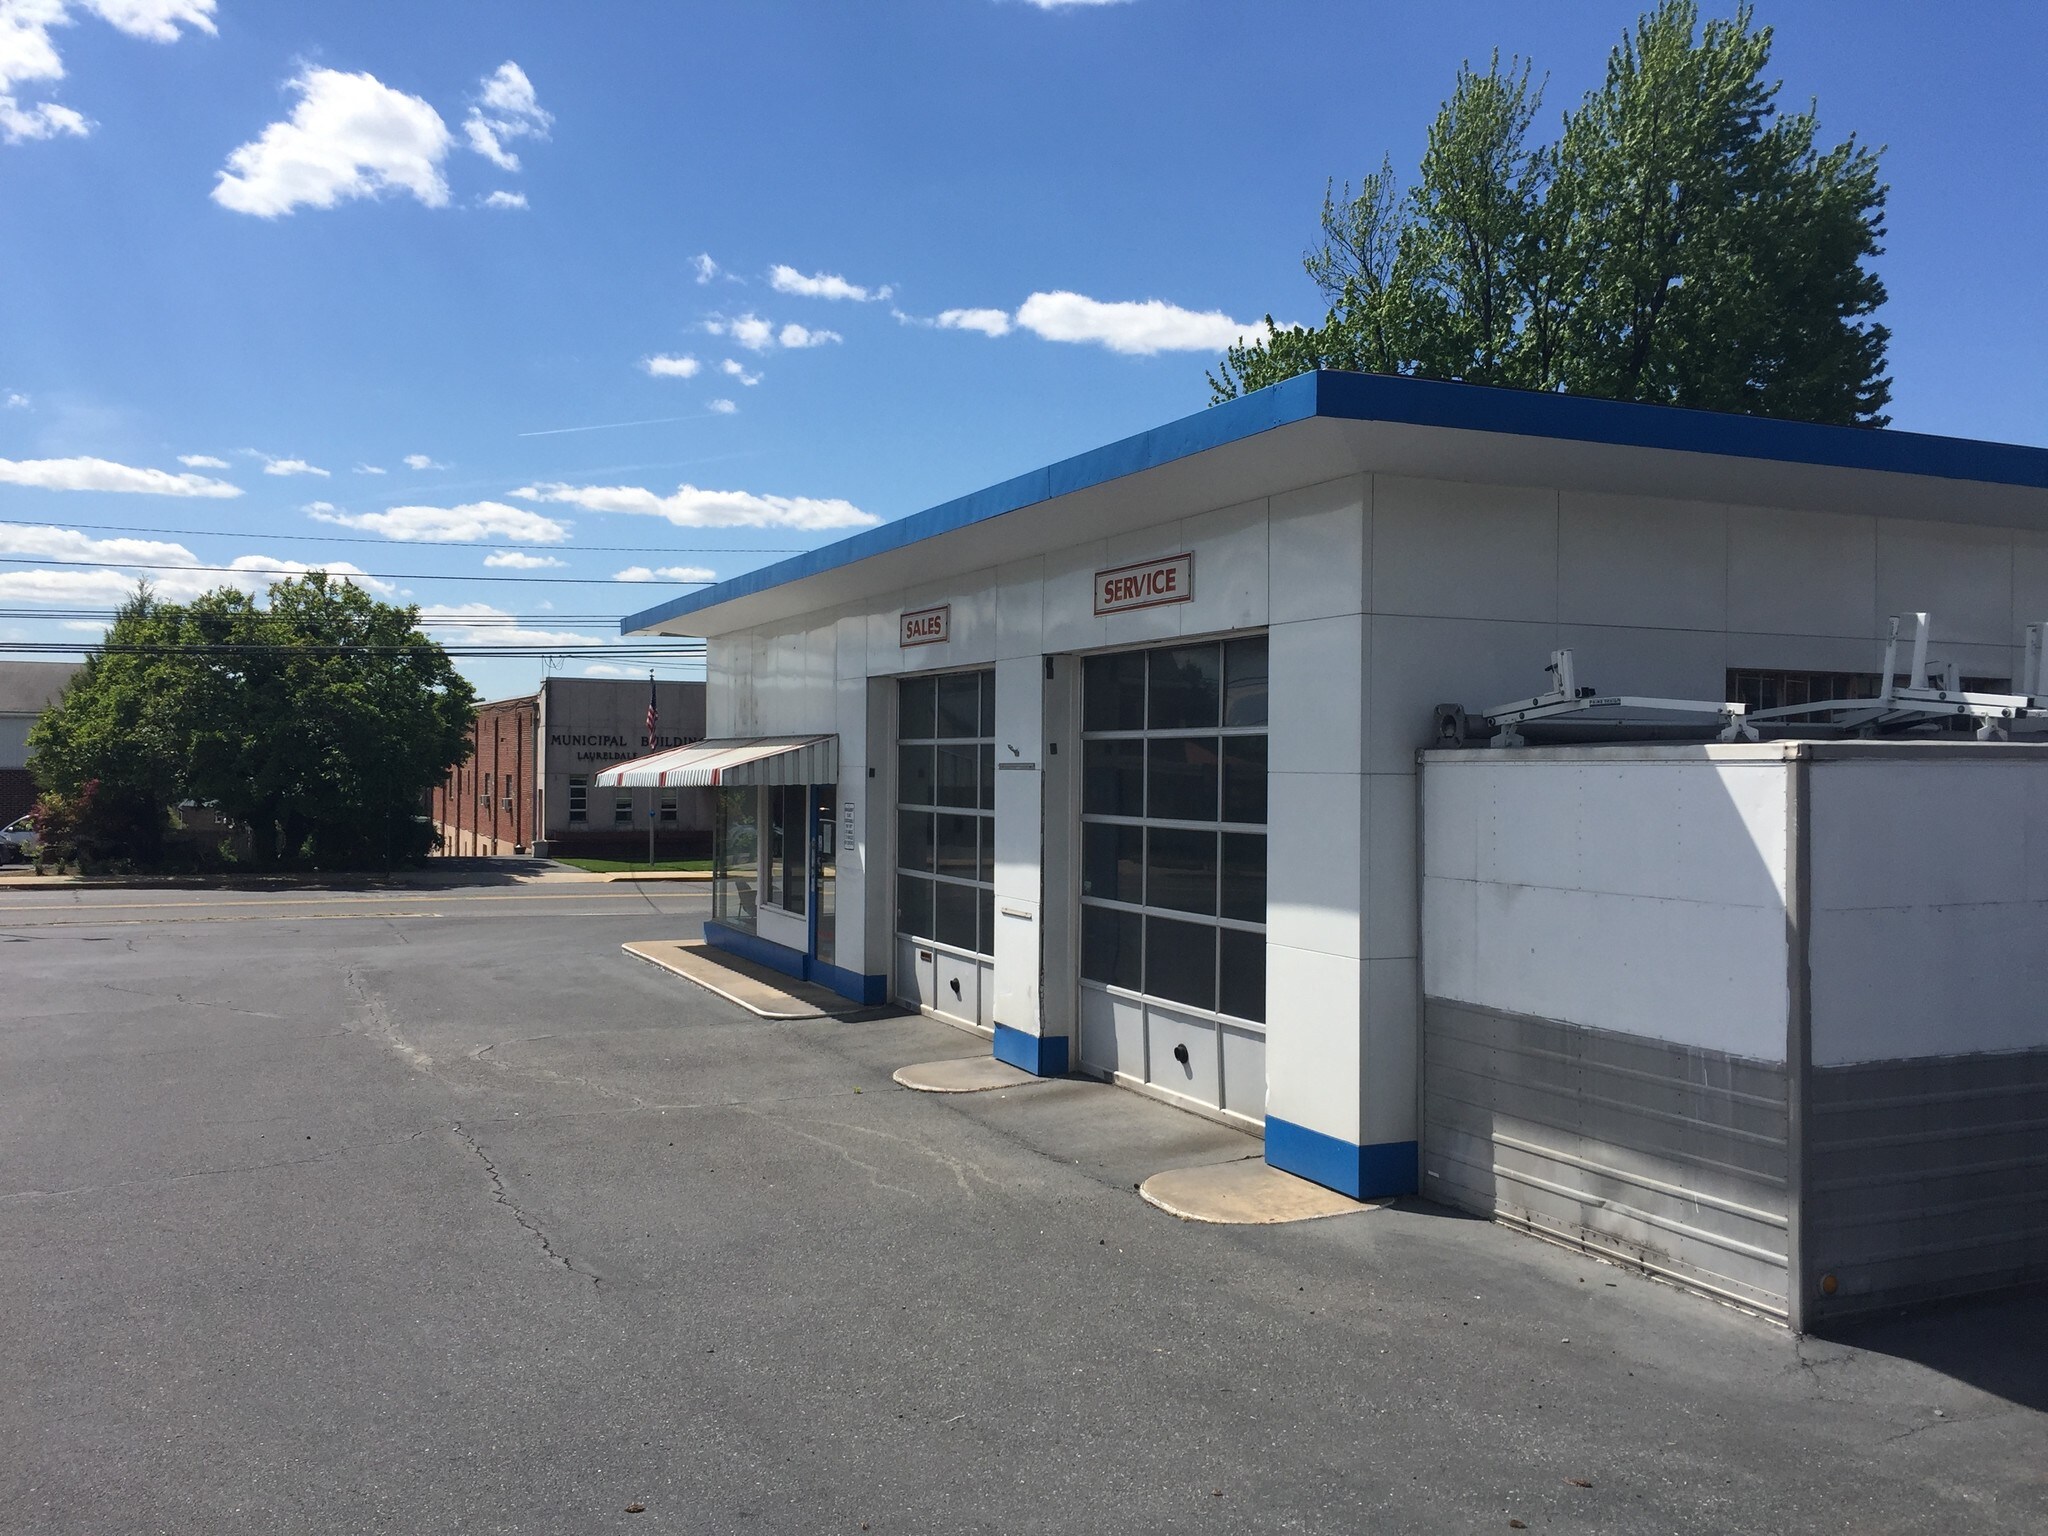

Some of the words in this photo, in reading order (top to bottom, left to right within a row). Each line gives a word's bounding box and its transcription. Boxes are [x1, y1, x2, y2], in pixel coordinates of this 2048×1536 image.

[1104, 568, 1177, 604] SERVICE
[906, 615, 941, 639] SALES
[551, 735, 627, 747] MUNICIPAL
[641, 736, 704, 747] BILDIN
[577, 752, 637, 761] LAURELDALE
